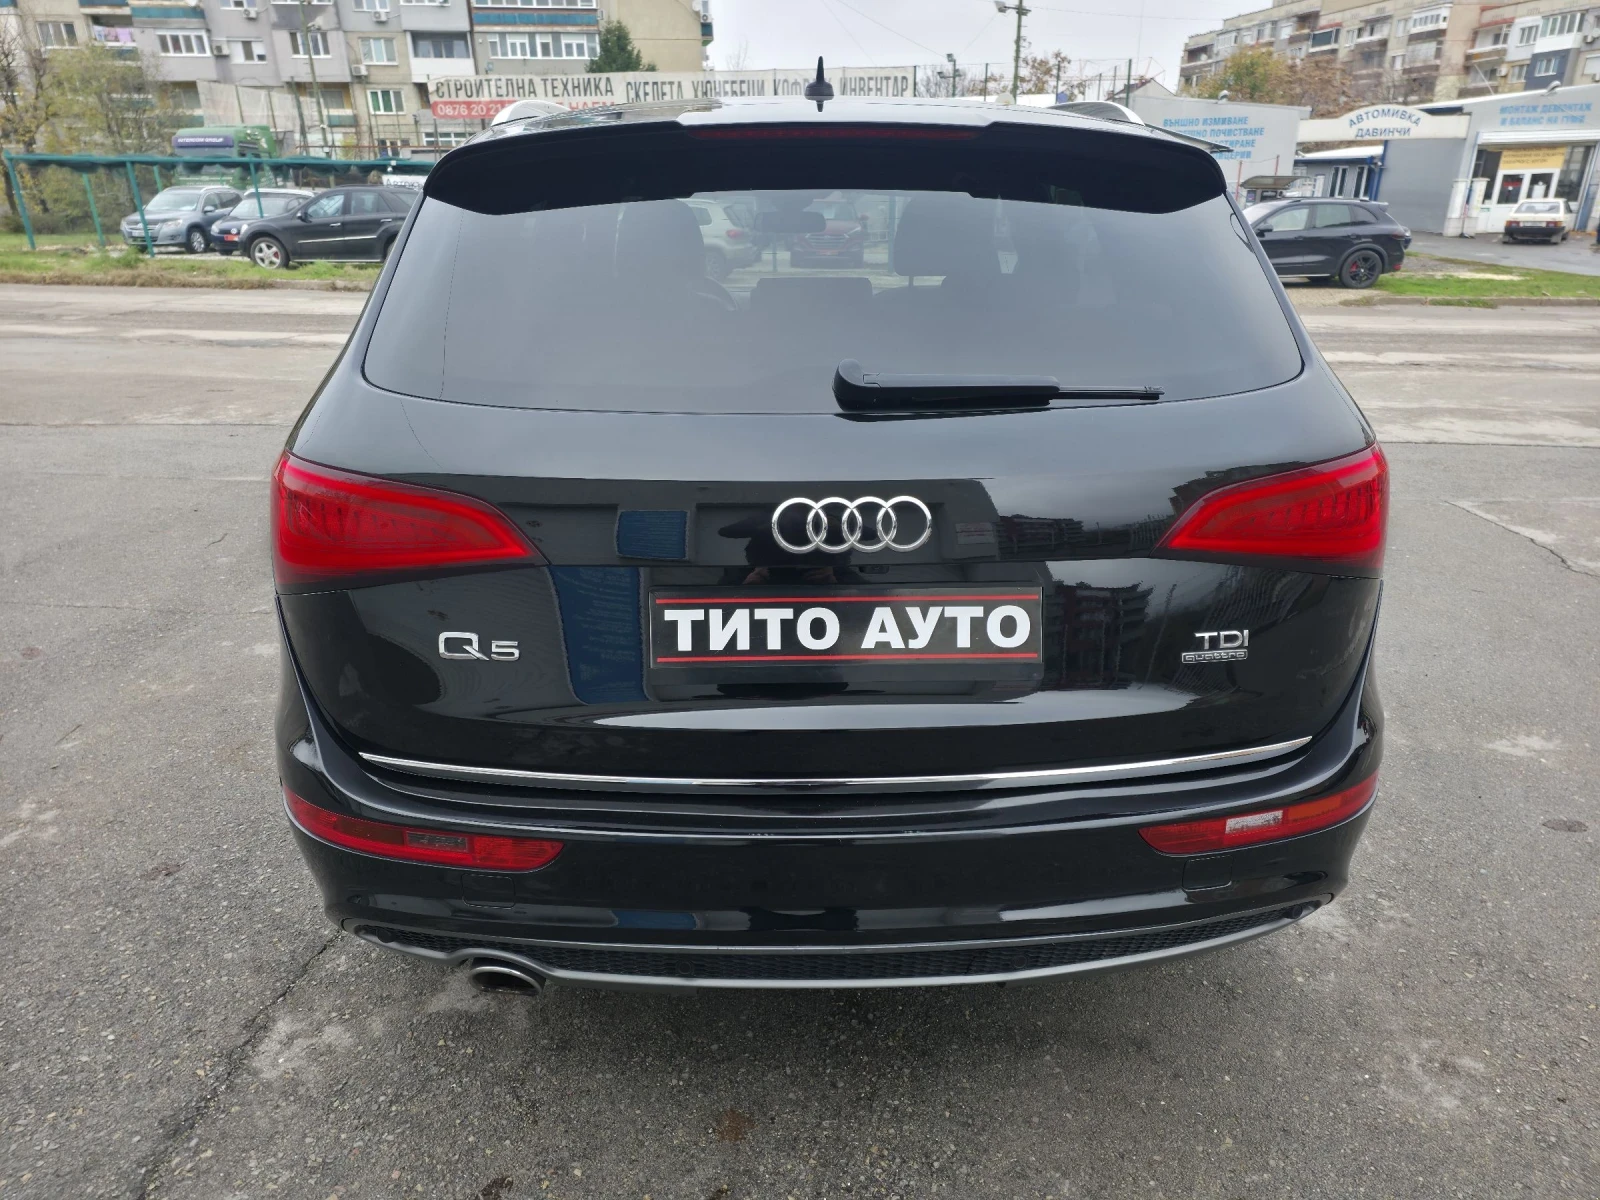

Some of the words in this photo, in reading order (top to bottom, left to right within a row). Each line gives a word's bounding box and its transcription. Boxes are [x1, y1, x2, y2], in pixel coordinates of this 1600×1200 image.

[435, 78, 537, 98] СТРОИТЕЛНА
[541, 76, 613, 97] ТЕХНИКА
[840, 76, 911, 97] ИНВЕНТАР
[437, 104, 468, 115] 0876
[470, 104, 486, 115] 20
[1202, 116, 1248, 126] ИЗМИВАНЕ
[1349, 108, 1421, 128] АВТОМИВКА
[1210, 127, 1264, 137] ПОЧИСТВАНЕ
[1355, 127, 1411, 138] ДАВИНЧИ
[664, 607, 840, 651] ТИТО
[861, 604, 1031, 650] АУТО
[438, 631, 520, 661] Q5
[1194, 629, 1249, 650] TDI
[1183, 650, 1247, 663] quattro
